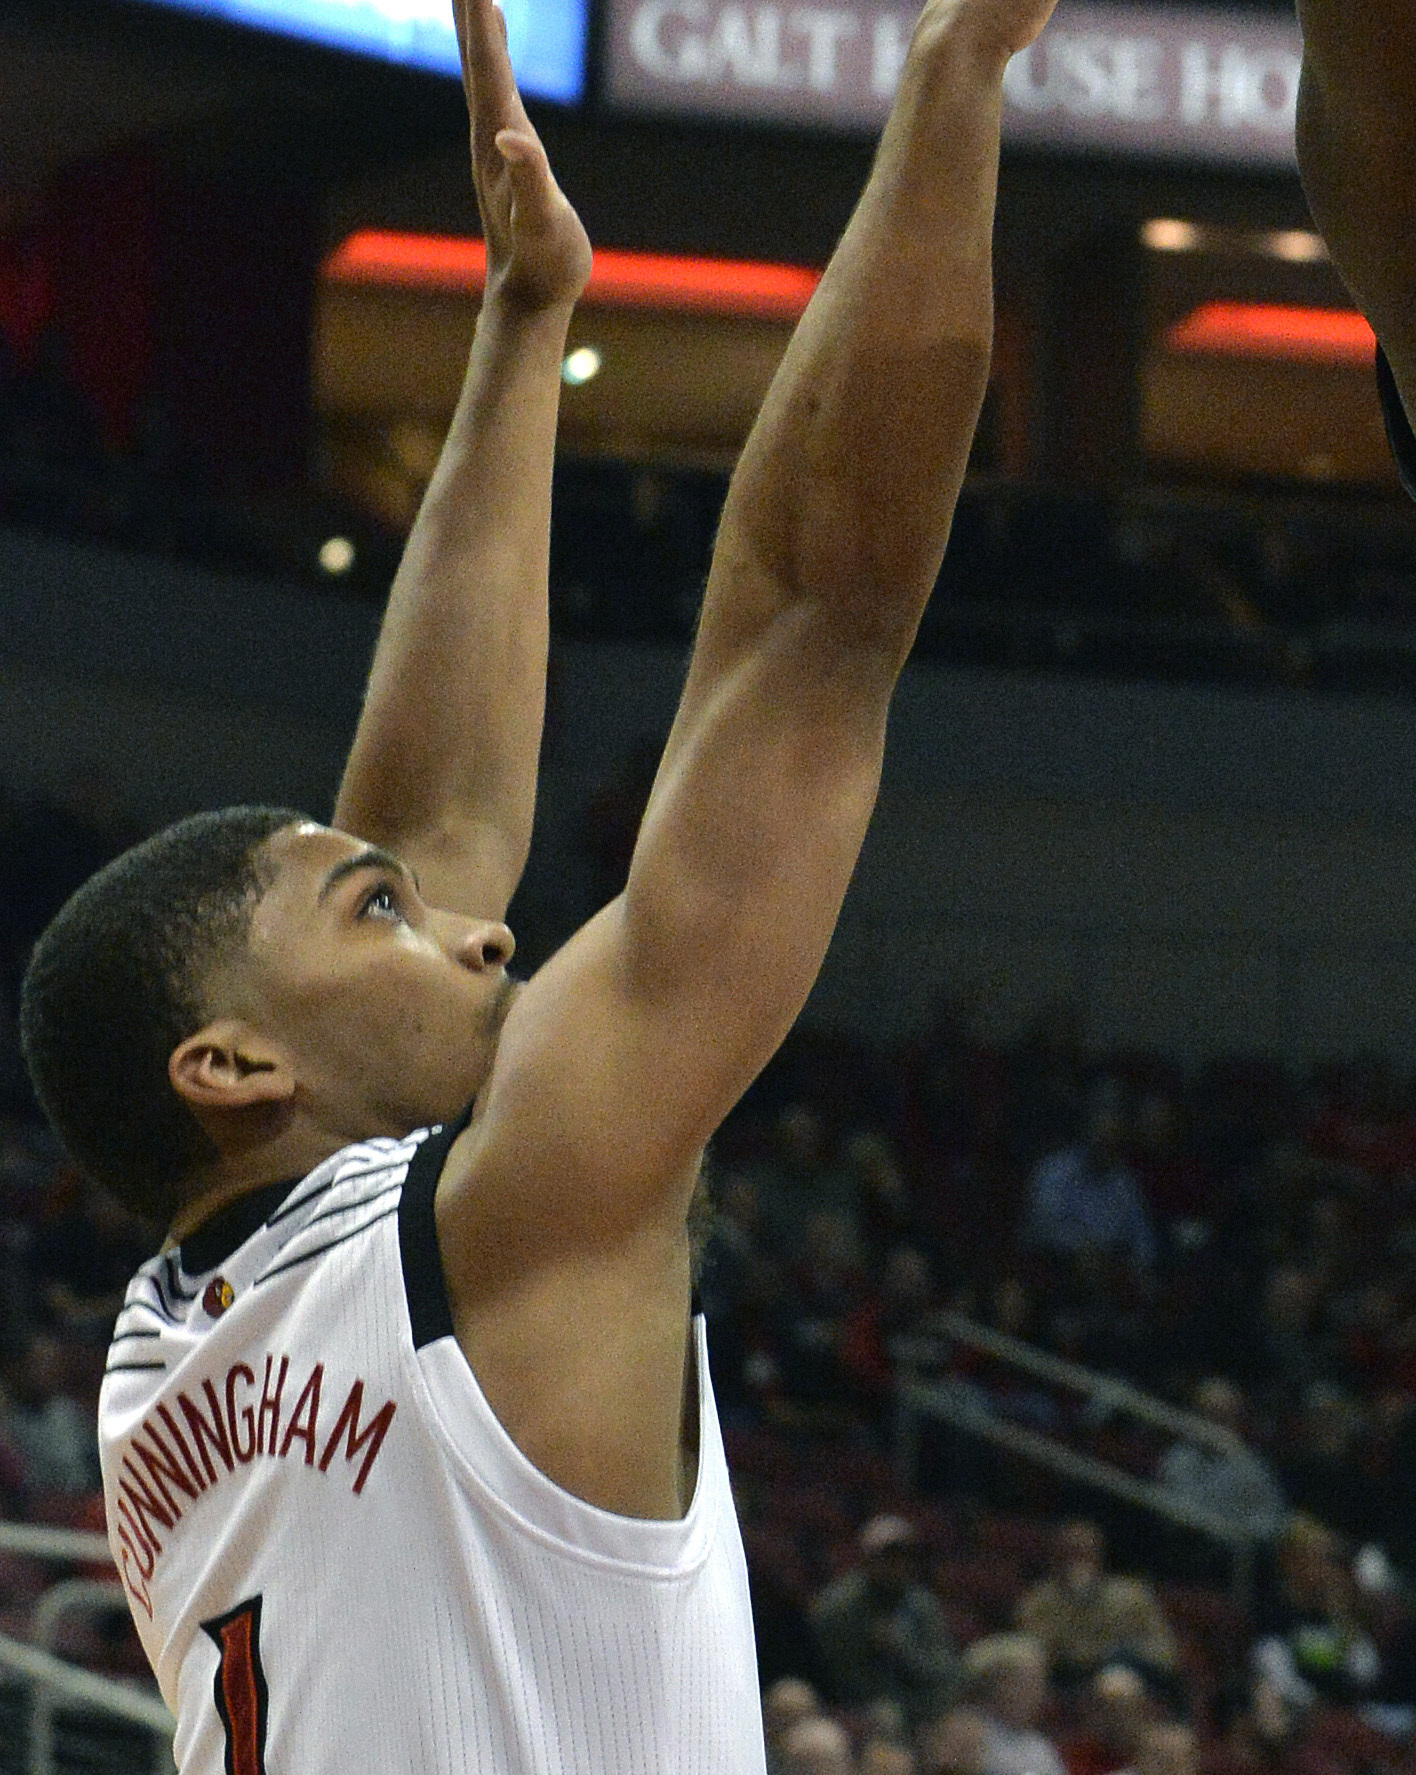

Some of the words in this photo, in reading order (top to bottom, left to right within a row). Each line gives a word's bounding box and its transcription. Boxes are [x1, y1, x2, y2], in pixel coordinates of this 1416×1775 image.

[870, 14, 1164, 122] HUSE
[1178, 36, 1302, 136] HO
[118, 1353, 397, 1622] CUNNINGHAM
[199, 1592, 270, 1775] 1
